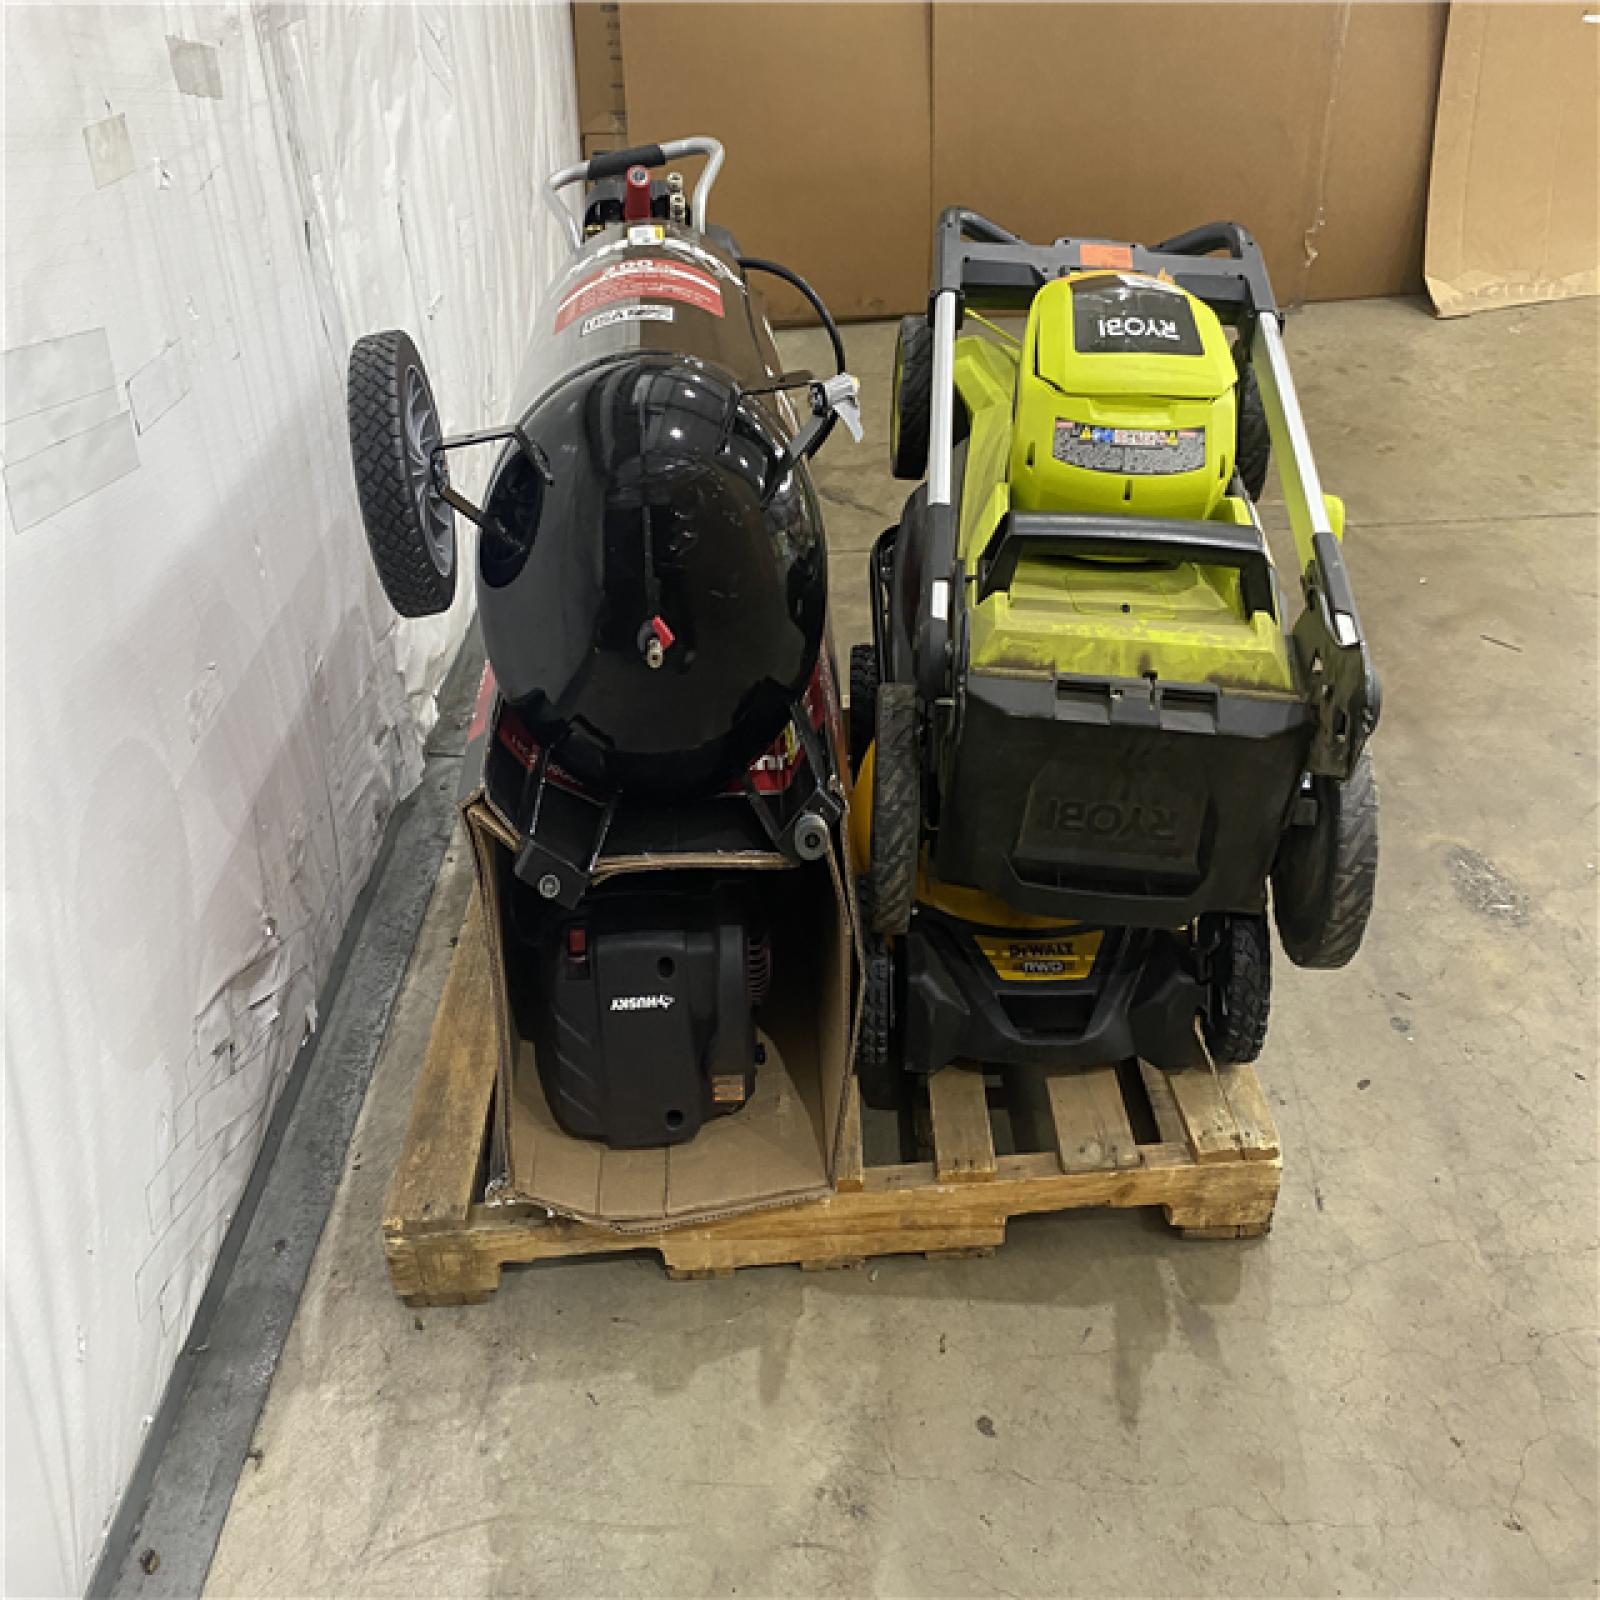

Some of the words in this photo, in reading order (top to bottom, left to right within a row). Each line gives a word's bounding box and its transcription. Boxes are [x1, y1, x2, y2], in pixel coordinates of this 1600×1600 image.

[1098, 317, 1180, 341] RYOBI
[1047, 800, 1176, 838] RYOBI
[609, 995, 658, 1010] HUSKY
